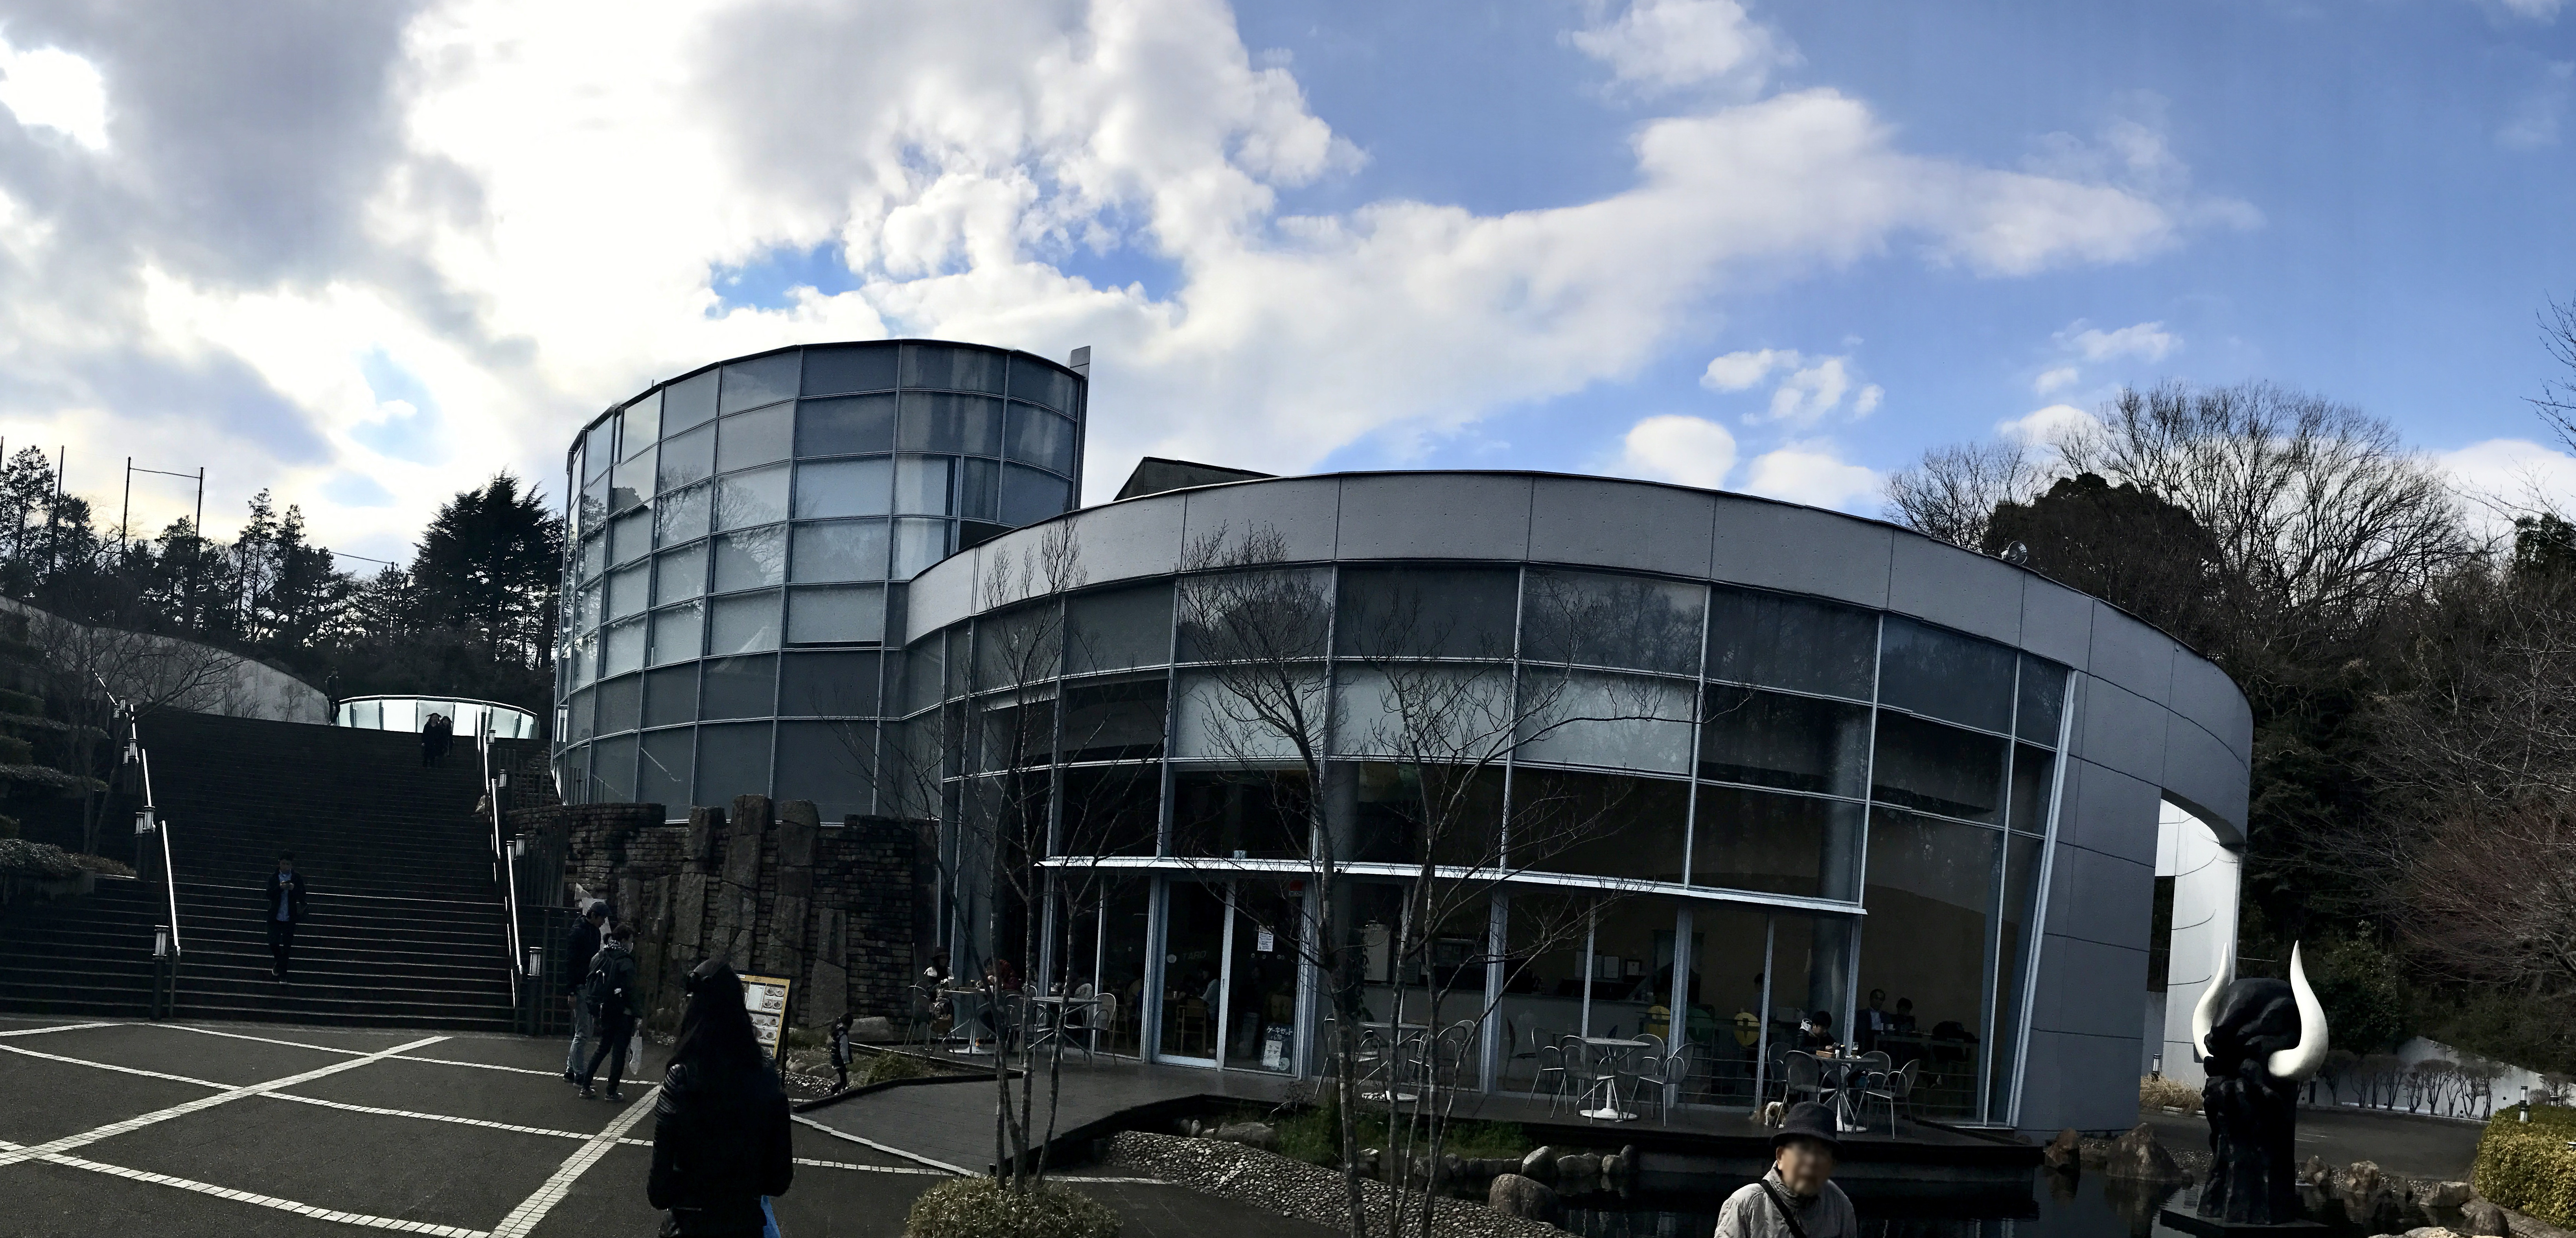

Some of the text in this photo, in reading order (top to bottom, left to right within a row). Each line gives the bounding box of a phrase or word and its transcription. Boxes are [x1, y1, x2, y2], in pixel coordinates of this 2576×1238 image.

[1183, 951, 1206, 960] TARO
[1267, 1026, 1293, 1035] ケーキセット
